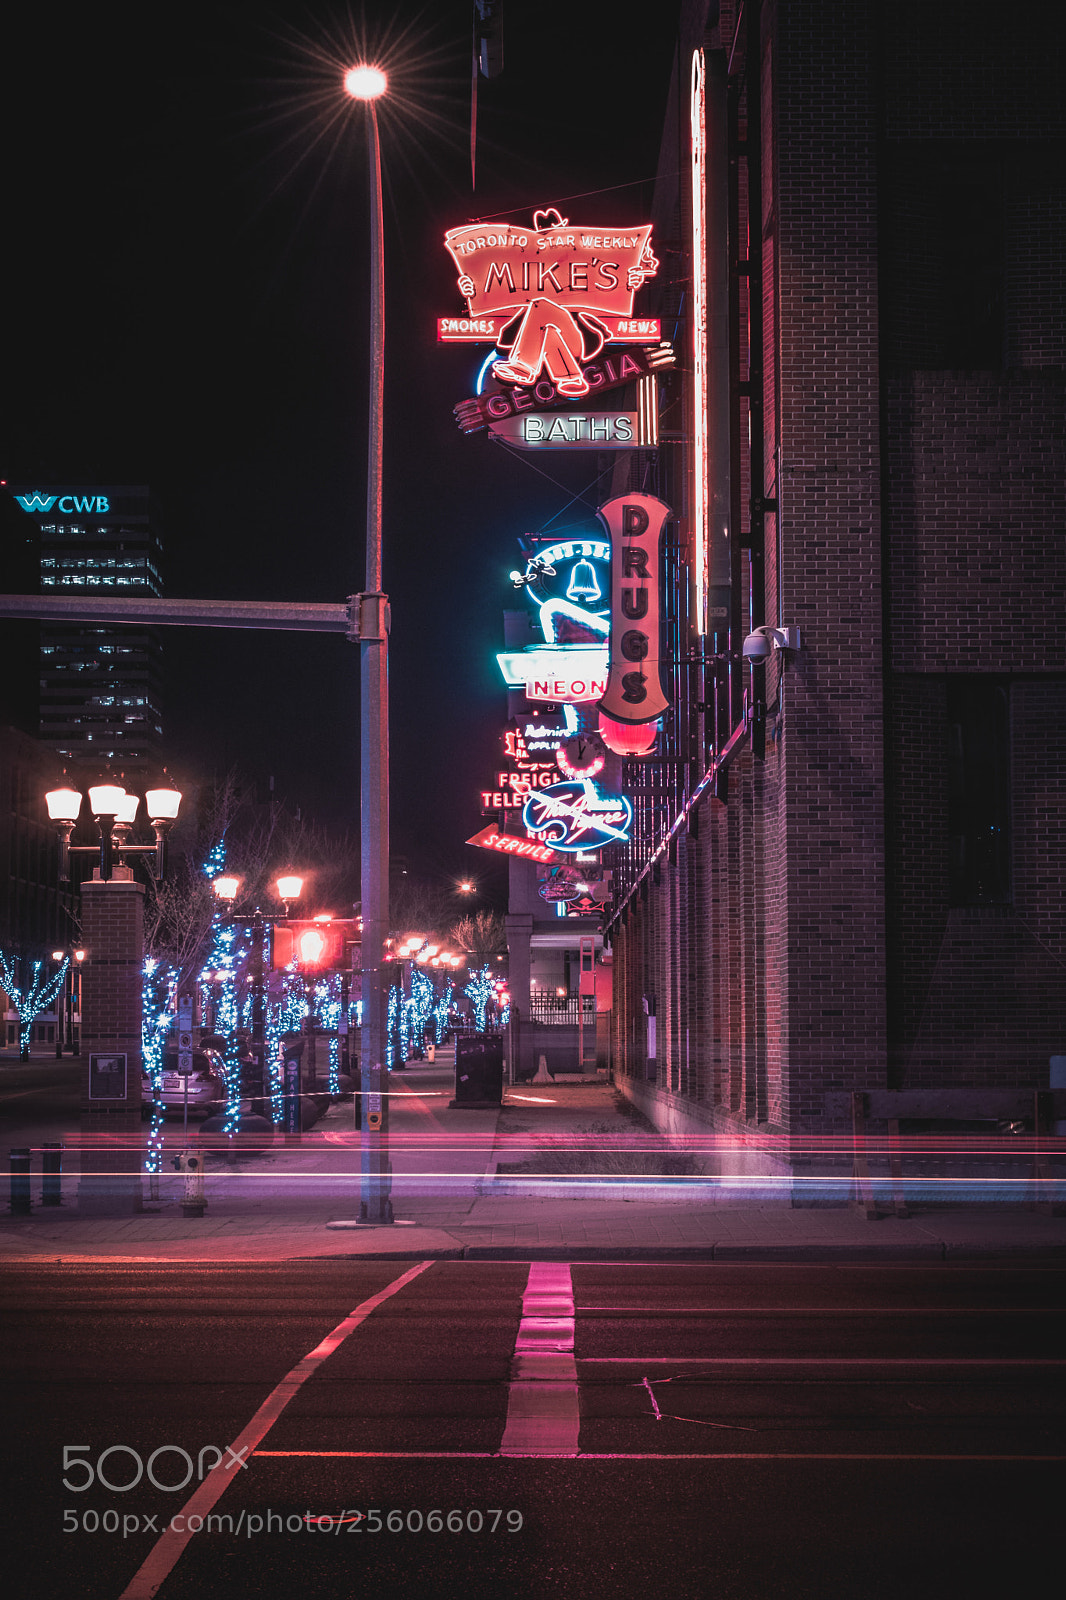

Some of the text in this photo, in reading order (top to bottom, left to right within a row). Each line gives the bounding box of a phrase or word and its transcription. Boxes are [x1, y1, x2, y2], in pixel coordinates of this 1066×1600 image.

[457, 235, 638, 254] TORONTO STAR WEEKLY
[484, 257, 619, 293] MIKE'S
[440, 319, 495, 335] SMOKES
[617, 320, 658, 334] NEWS
[486, 353, 642, 419] GEOGIA
[524, 417, 634, 441] BATHS
[58, 495, 110, 513] CWB
[621, 504, 653, 705] DRUGS
[534, 680, 604, 695] NEON
[484, 835, 555, 860] SERVICE
